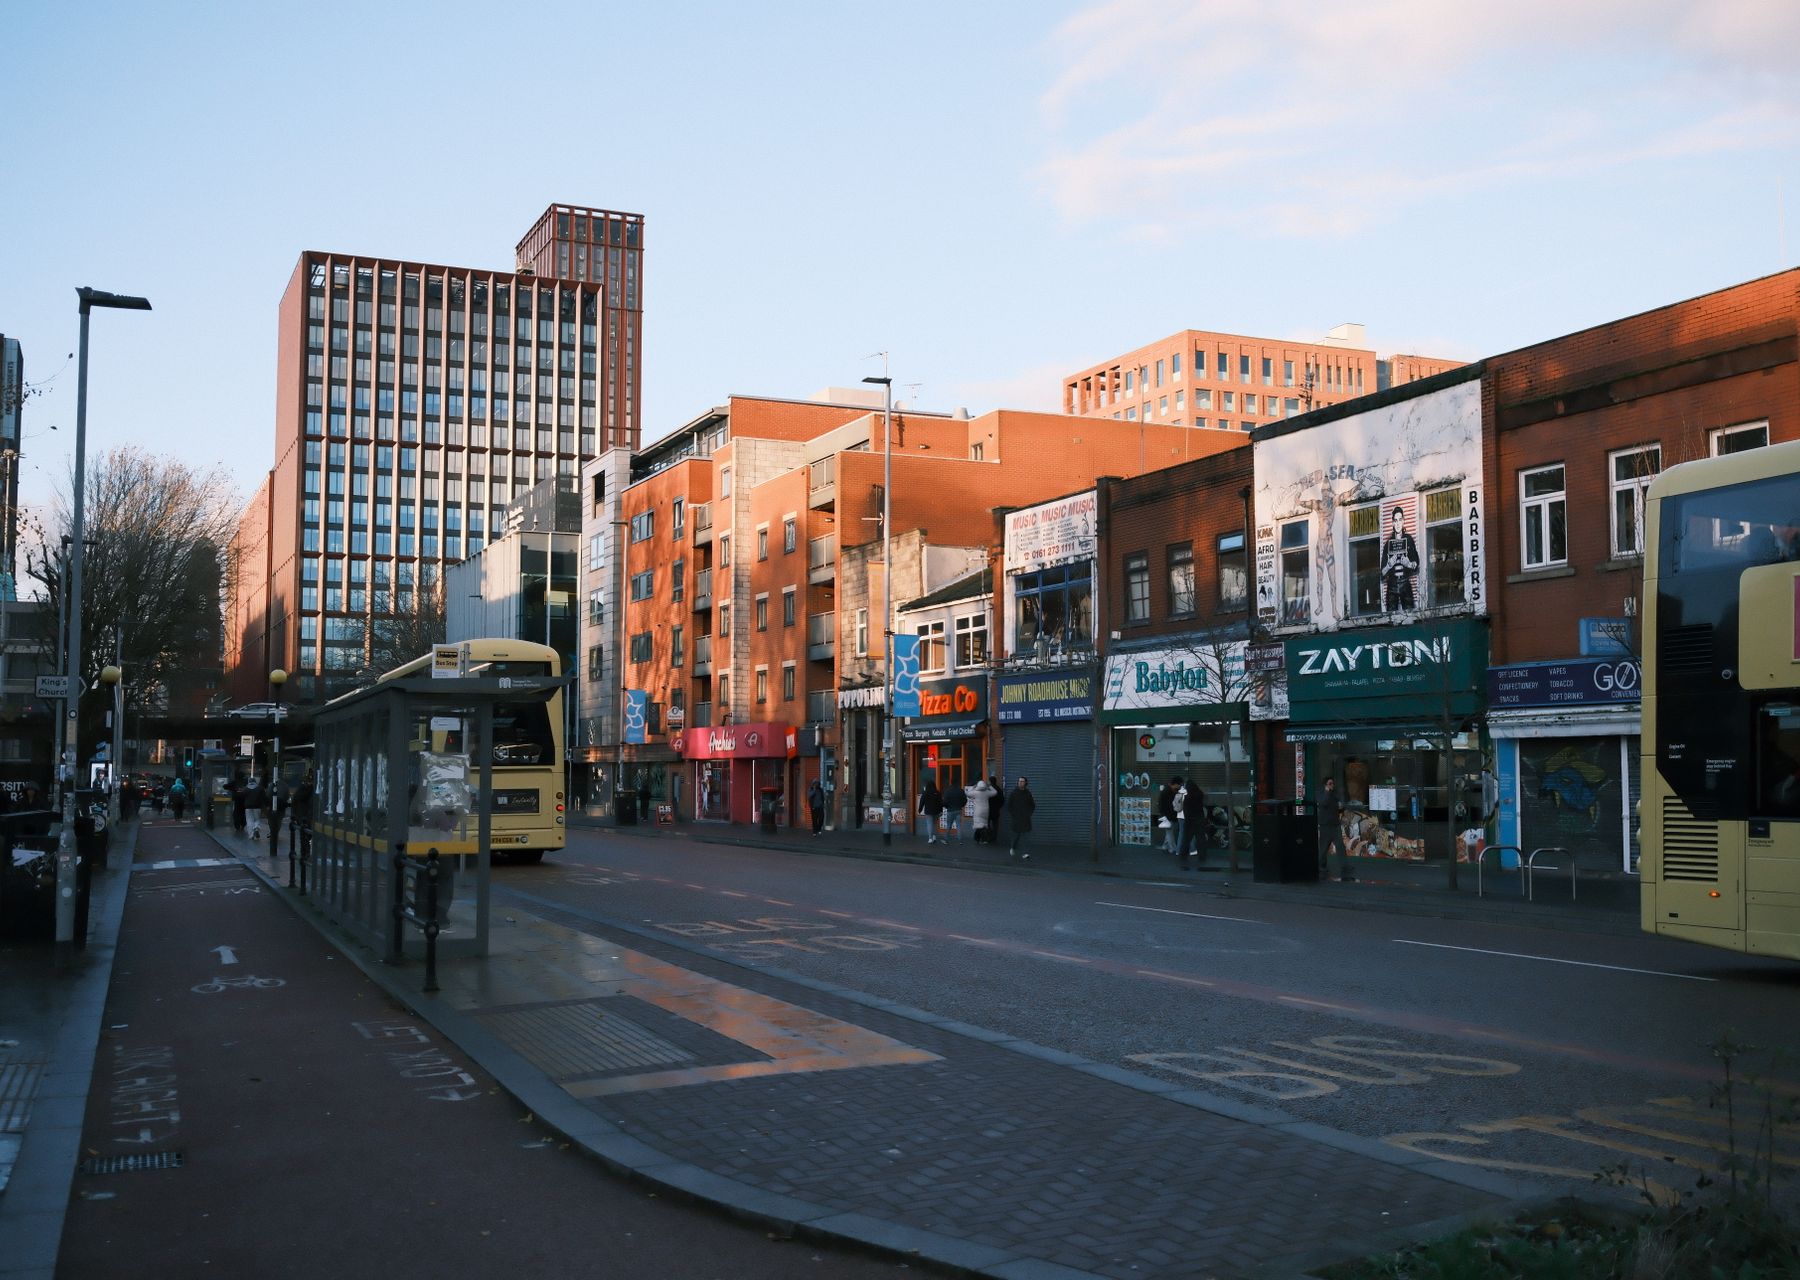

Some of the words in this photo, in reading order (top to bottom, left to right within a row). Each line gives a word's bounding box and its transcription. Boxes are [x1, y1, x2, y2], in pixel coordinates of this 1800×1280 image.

[1329, 464, 1356, 480] SEA
[1012, 513, 1037, 530] MUSIC
[1041, 504, 1067, 522] MUSIC
[1068, 498, 1096, 516] MUSIC
[1032, 549, 1046, 559] 0161
[1047, 544, 1060, 555] 273
[1061, 541, 1075, 552] 1111
[1258, 544, 1275, 555] AFRO
[1468, 490, 1481, 600] BARBERS
[1259, 561, 1273, 570] HAIR
[1258, 575, 1275, 584] BEAUTY
[1498, 671, 1508, 679] OFF
[1508, 669, 1529, 678] LICENCE
[1549, 667, 1566, 675] VAPES
[41, 678, 67, 687] King's
[1135, 660, 1208, 697] Babylon
[1550, 679, 1574, 688] TOBACCO
[1000, 684, 1027, 704] JOHNNY
[1028, 680, 1069, 702] ROADHOUSE
[1499, 682, 1539, 691] CONFECTIONERY
[954, 685, 977, 713] Co
[1550, 693, 1563, 701] SOFT
[1564, 692, 1584, 700] DRINKS
[653, 917, 838, 937] BUS
[1125, 1034, 1522, 1100] BUS
